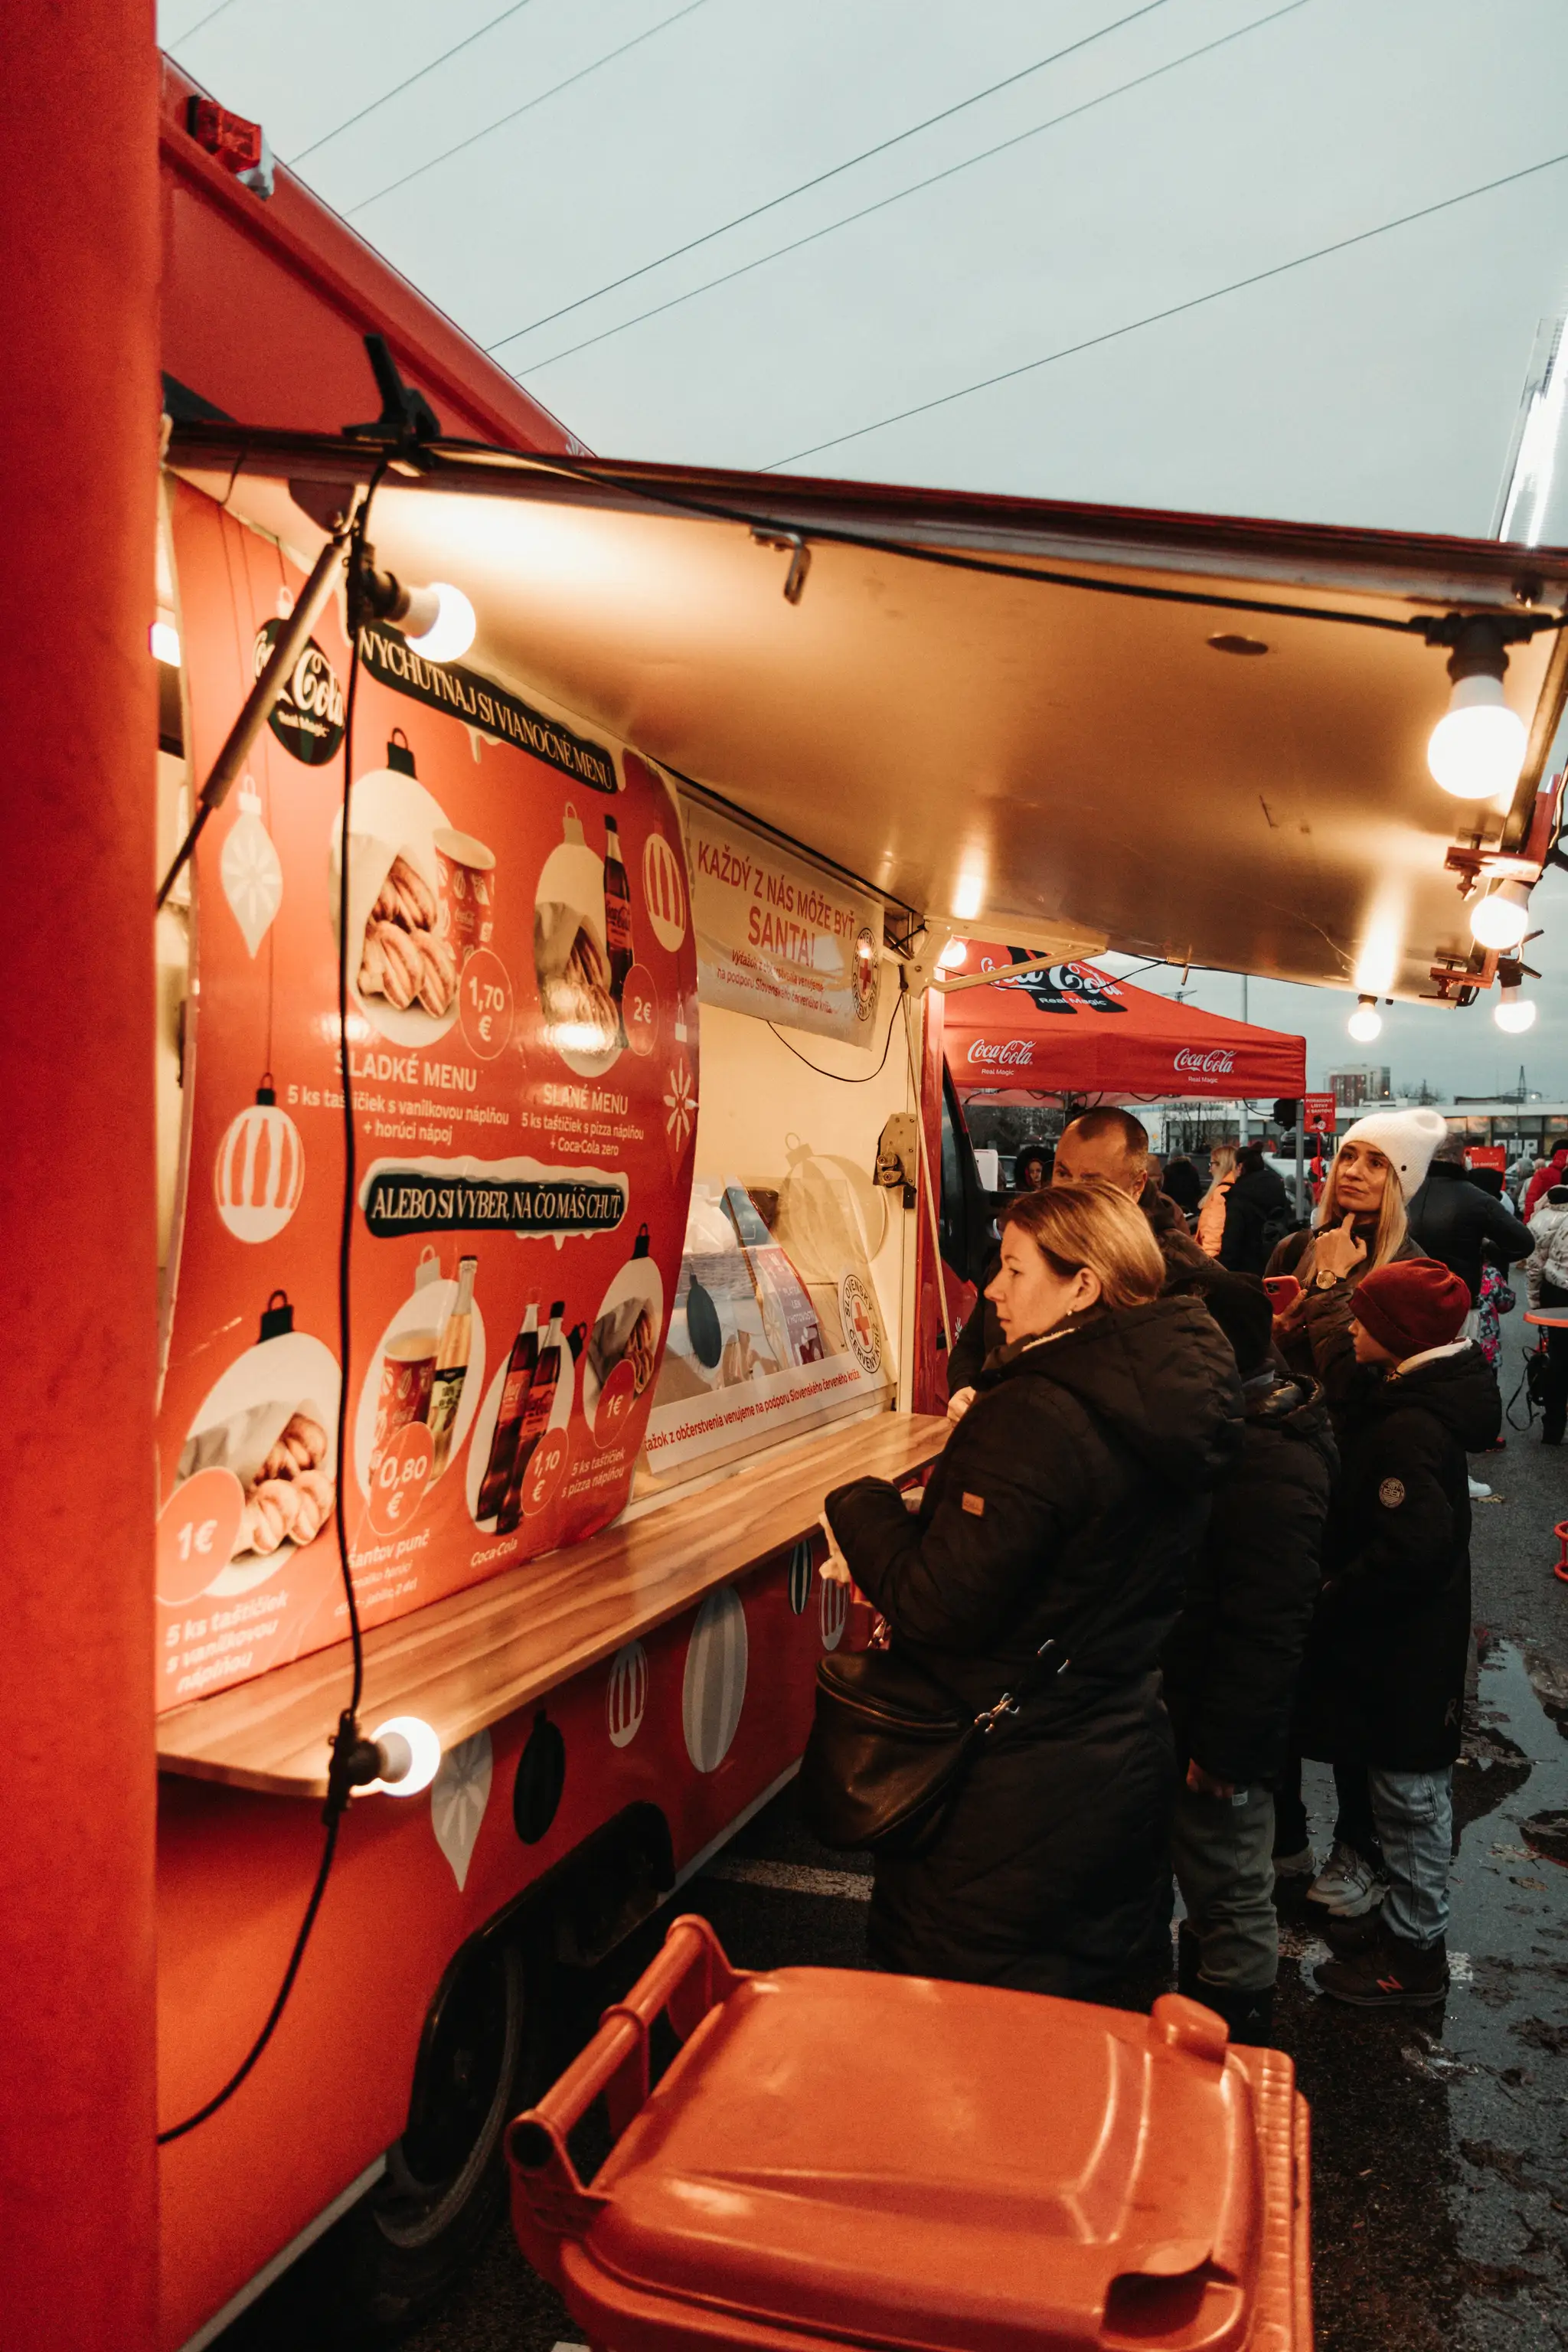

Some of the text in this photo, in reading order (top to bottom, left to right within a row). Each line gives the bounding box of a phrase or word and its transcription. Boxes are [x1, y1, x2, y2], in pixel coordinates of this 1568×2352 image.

[360, 626, 612, 790] VYCHUTNAJ SI VIANOČNÉ MENU
[698, 840, 855, 940] KAŽDÝ Z NÁS MÔŽE BYŤ
[748, 906, 815, 968] SANTA!
[717, 967, 726, 979] na
[727, 968, 754, 988] podporu
[469, 975, 505, 1013] 1,70
[1069, 998, 1107, 1006] Magic
[633, 996, 652, 1024] 2€
[479, 1015, 493, 1042] €
[967, 1038, 1037, 1065] Coca-Cola
[1173, 1047, 1238, 1073] Coca-Cola
[423, 1061, 477, 1093] MENU
[287, 1084, 509, 1125] 5 ks tašičiek s vanilkovou náplňou
[544, 1083, 629, 1115] SLANÉ MENU
[362, 1119, 453, 1146] + horúci nápoj
[521, 1112, 645, 1141] 5 ks taštičiek s pizza náplňou
[557, 1137, 600, 1155] Coca-Cola
[601, 1144, 619, 1156] zero
[371, 1185, 621, 1222] ALEBO SI VYBER, NA ČO MÁŠ CHUŤ.
[607, 1394, 624, 1419] 1€
[644, 1432, 669, 1452] ťažok
[669, 1431, 675, 1444] z
[676, 1413, 724, 1442] občerstvenia
[724, 1406, 755, 1424] venujeme
[756, 1402, 764, 1413] na
[764, 1393, 790, 1414] podporu
[789, 1380, 823, 1402] Slovenského
[822, 1373, 848, 1391] červeného
[379, 1455, 428, 1491] 0,80
[534, 1449, 560, 1478] 1,10
[571, 1462, 578, 1476] 5
[580, 1460, 590, 1473] ks
[532, 1479, 546, 1502] €
[561, 1487, 567, 1498] s
[567, 1479, 590, 1498] pizza
[387, 1491, 404, 1519] €
[178, 1519, 218, 1561] 1€
[395, 1529, 430, 1560] punč
[470, 1537, 518, 1568] Coca-Cola
[165, 1623, 181, 1648] 5
[184, 1619, 207, 1642] ks
